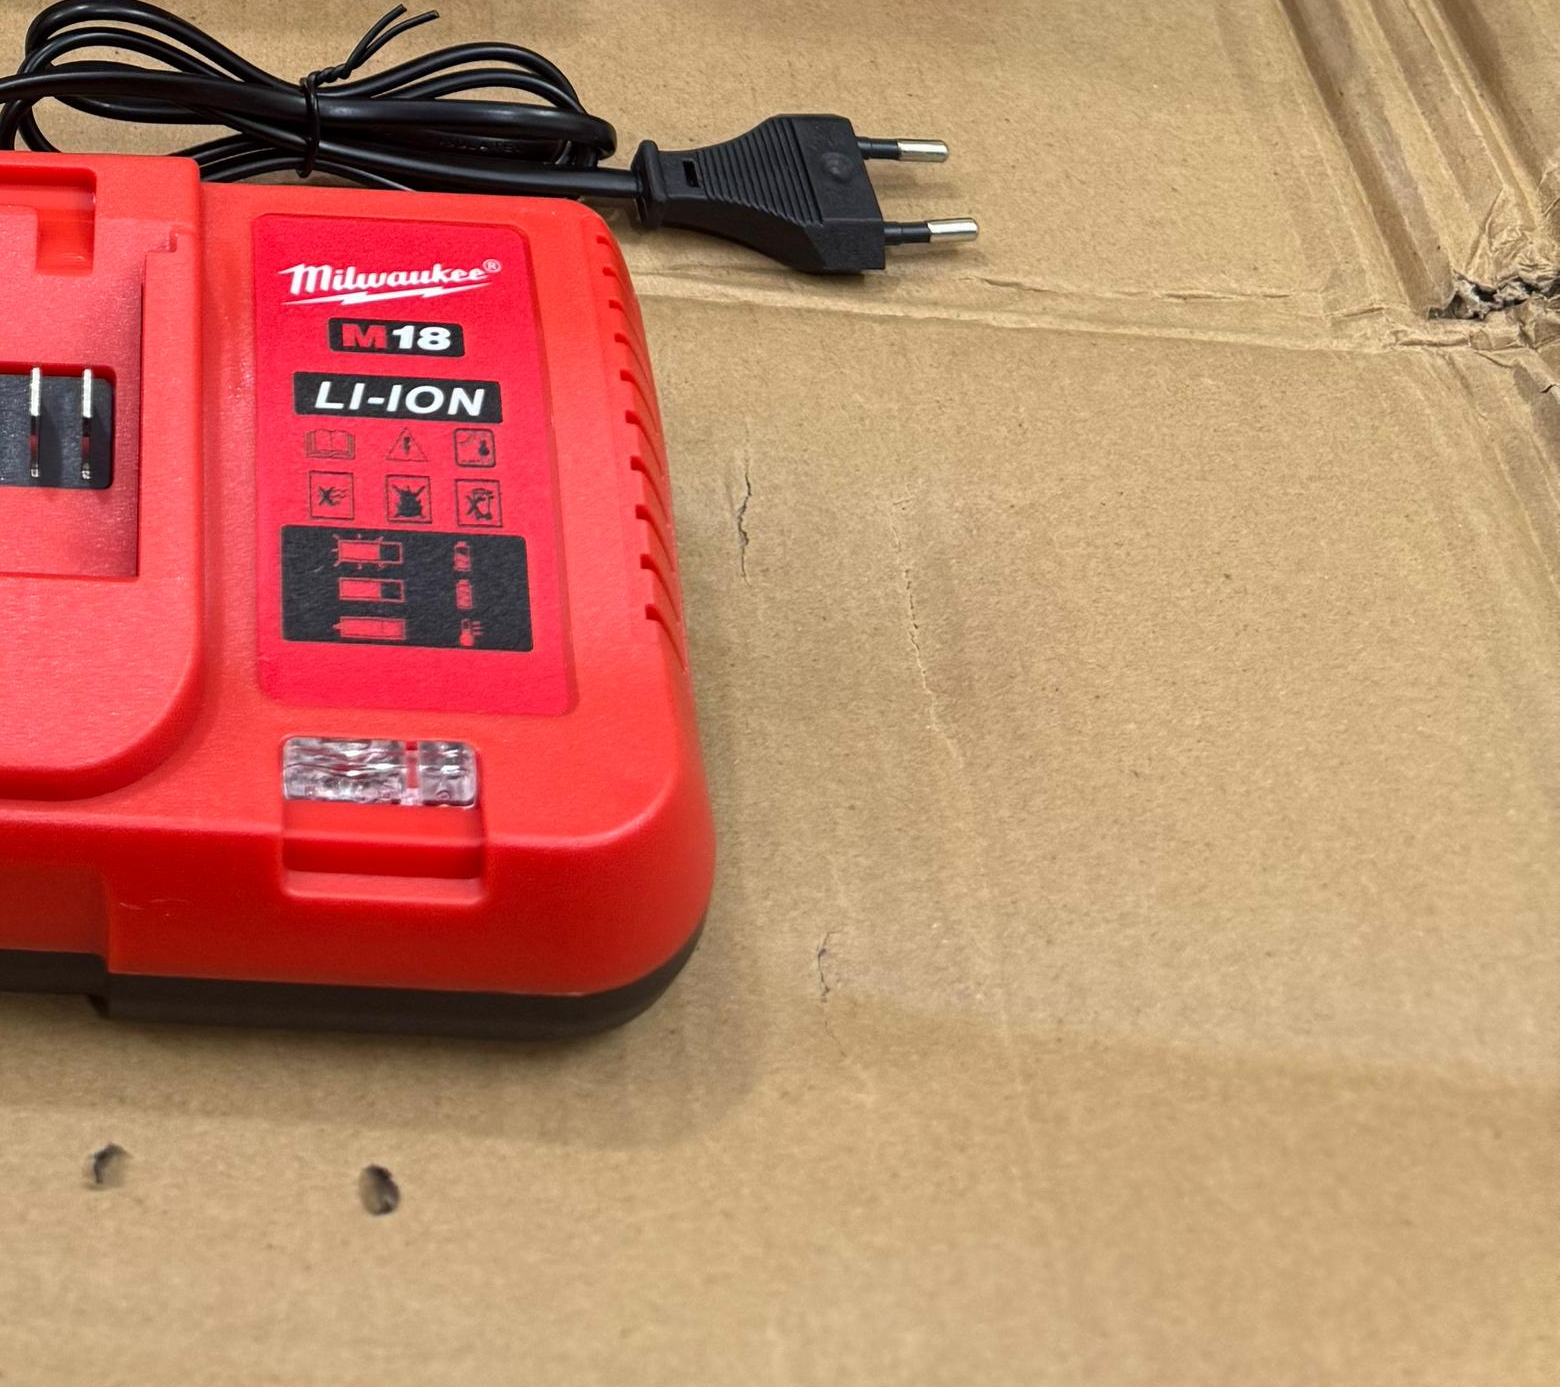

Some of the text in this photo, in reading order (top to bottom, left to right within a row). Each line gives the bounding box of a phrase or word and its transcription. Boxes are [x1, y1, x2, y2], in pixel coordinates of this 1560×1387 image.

[278, 262, 488, 295] Milwaukee
[341, 322, 452, 351] M18
[314, 380, 486, 417] LI-ION
